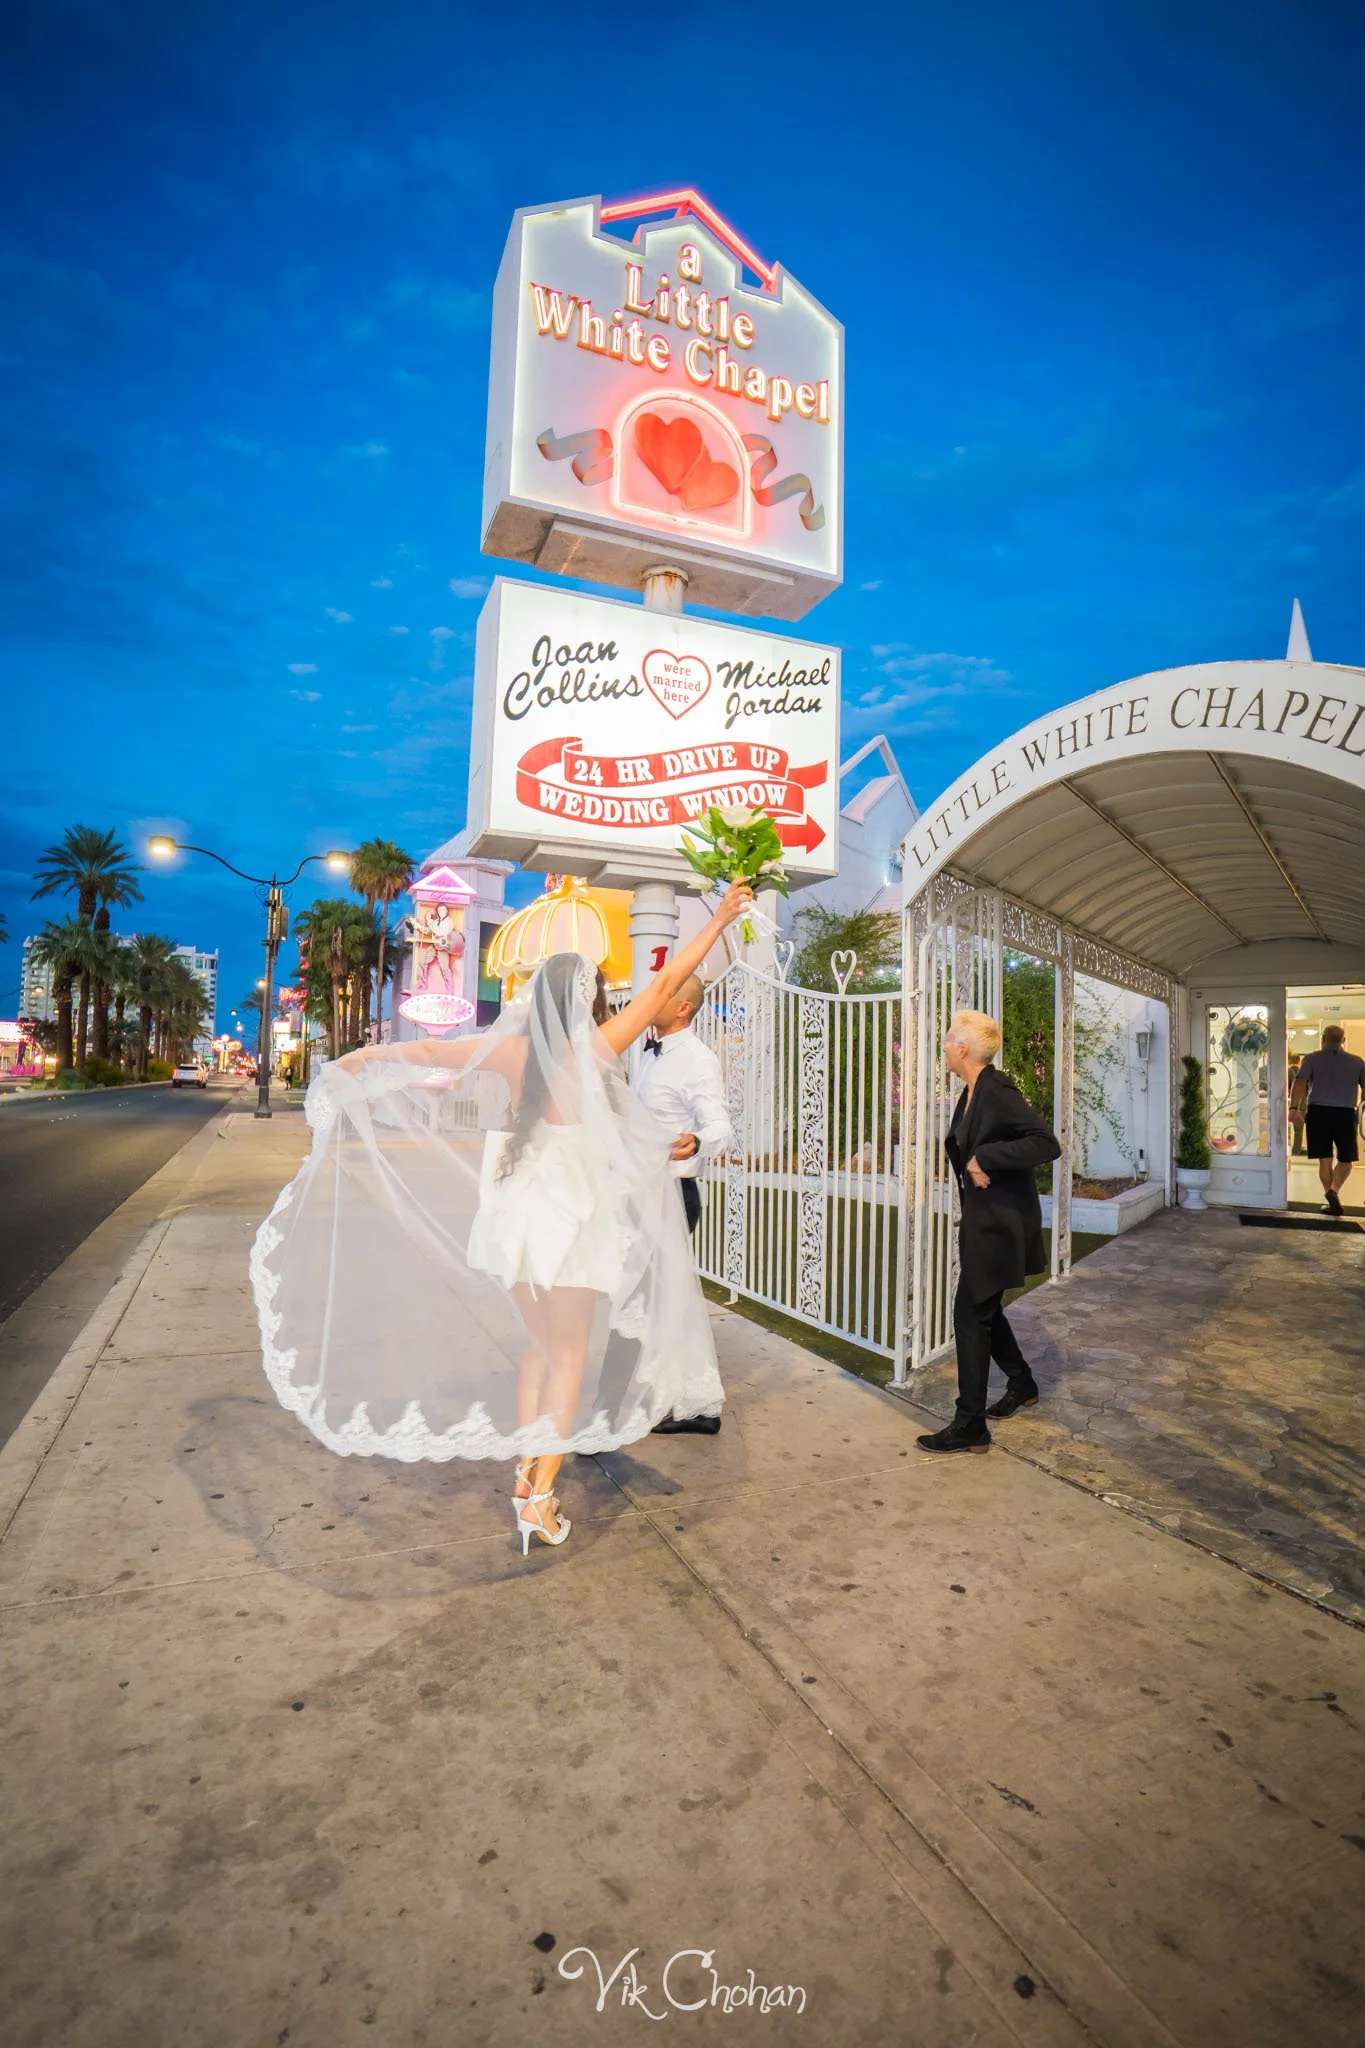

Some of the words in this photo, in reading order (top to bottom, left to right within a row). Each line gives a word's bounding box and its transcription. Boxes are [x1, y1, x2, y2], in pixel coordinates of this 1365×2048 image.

[678, 243, 702, 283] a
[624, 262, 755, 349] Little
[529, 281, 671, 372] White
[683, 337, 830, 424] Chapel
[531, 635, 619, 686] Joan
[663, 662, 691, 677] were
[716, 657, 831, 690] Michael
[503, 668, 644, 721] Collins
[653, 674, 701, 693] married
[663, 687, 690, 704] here
[724, 692, 822, 729] Jordan
[573, 759, 604, 786] 24
[616, 758, 654, 784] HR
[661, 744, 738, 781] DRIVE
[749, 746, 781, 771] UP
[912, 759, 1011, 868] LITTLE
[1021, 696, 1149, 773] WHITE
[1170, 687, 1365, 756] CHAPEL
[538, 783, 669, 824] WEDDING
[679, 783, 788, 817] WINDOW
